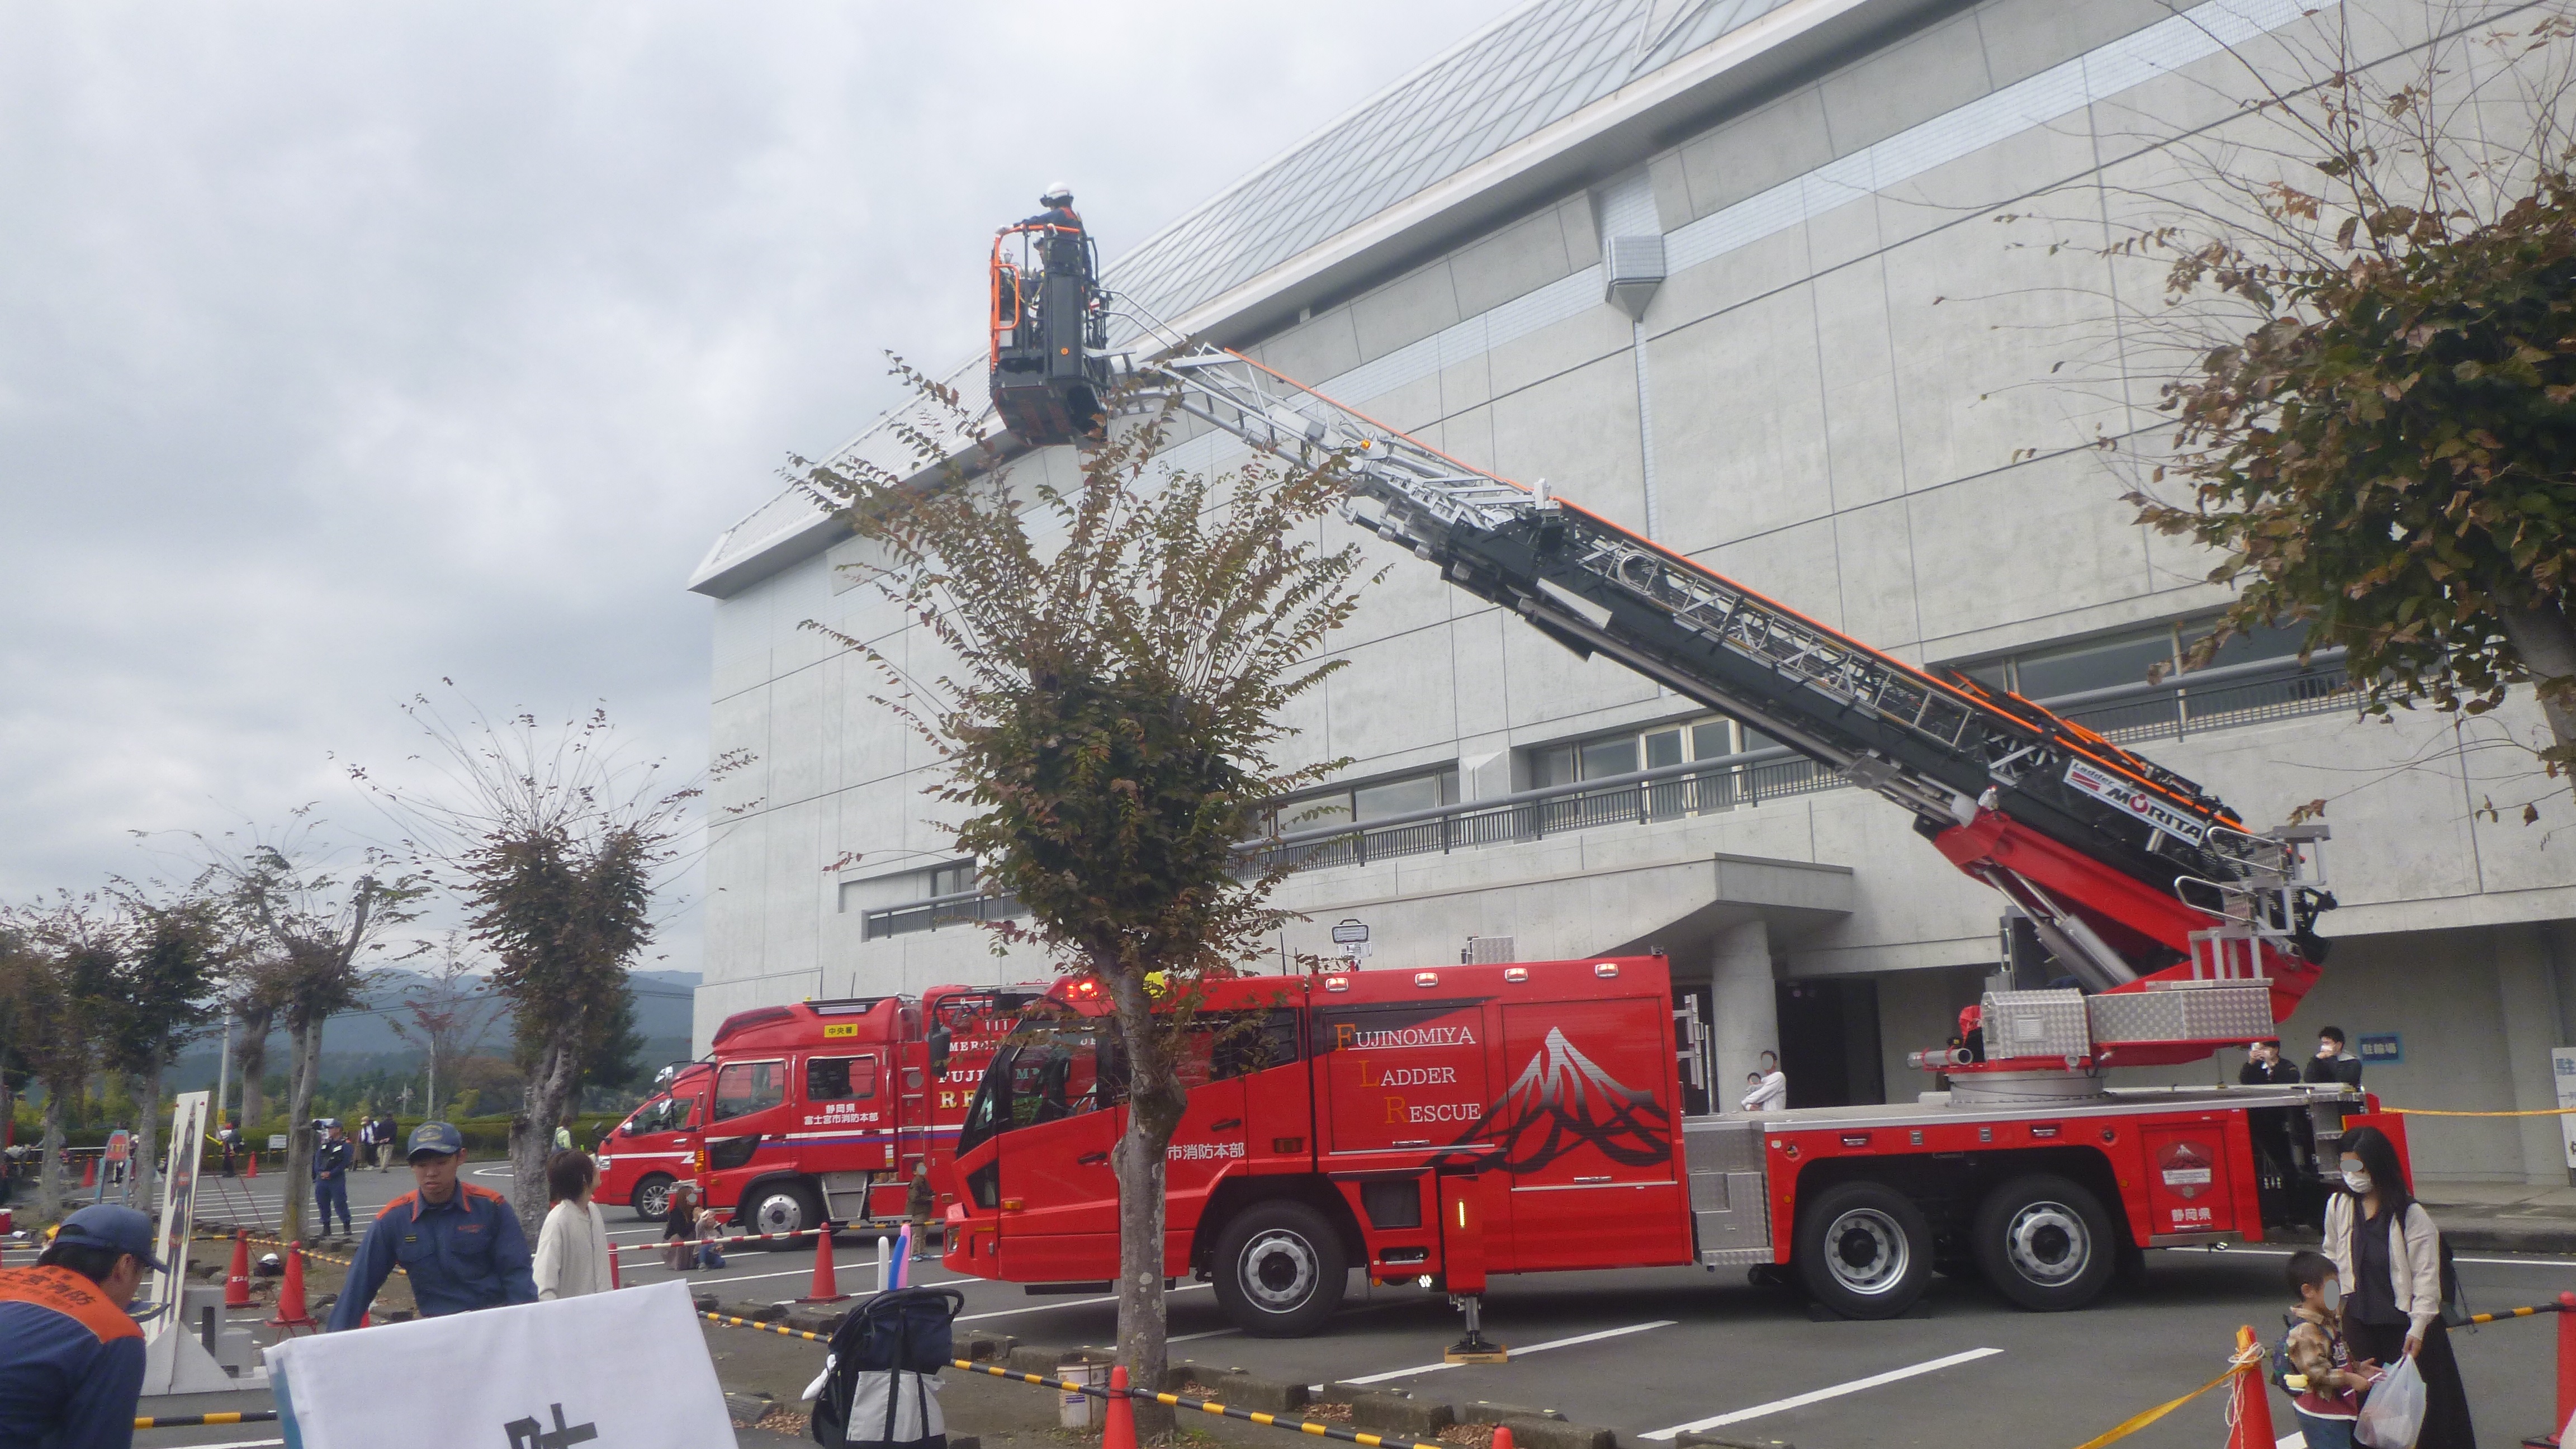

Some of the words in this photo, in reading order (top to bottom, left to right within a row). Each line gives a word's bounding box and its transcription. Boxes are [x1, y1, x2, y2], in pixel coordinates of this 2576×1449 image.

[2105, 787, 2201, 840] MORITA
[1334, 1023, 1476, 1051] FUJINOMIYA
[1358, 1060, 1457, 1087] LADDER
[804, 1112, 879, 1125] 富士宮市消防本部
[826, 1104, 856, 1114] 静岡県
[1385, 1096, 1481, 1124] RESCUE
[1168, 1142, 1244, 1161] 市消防本部
[2171, 1208, 2212, 1221] 静岡県
